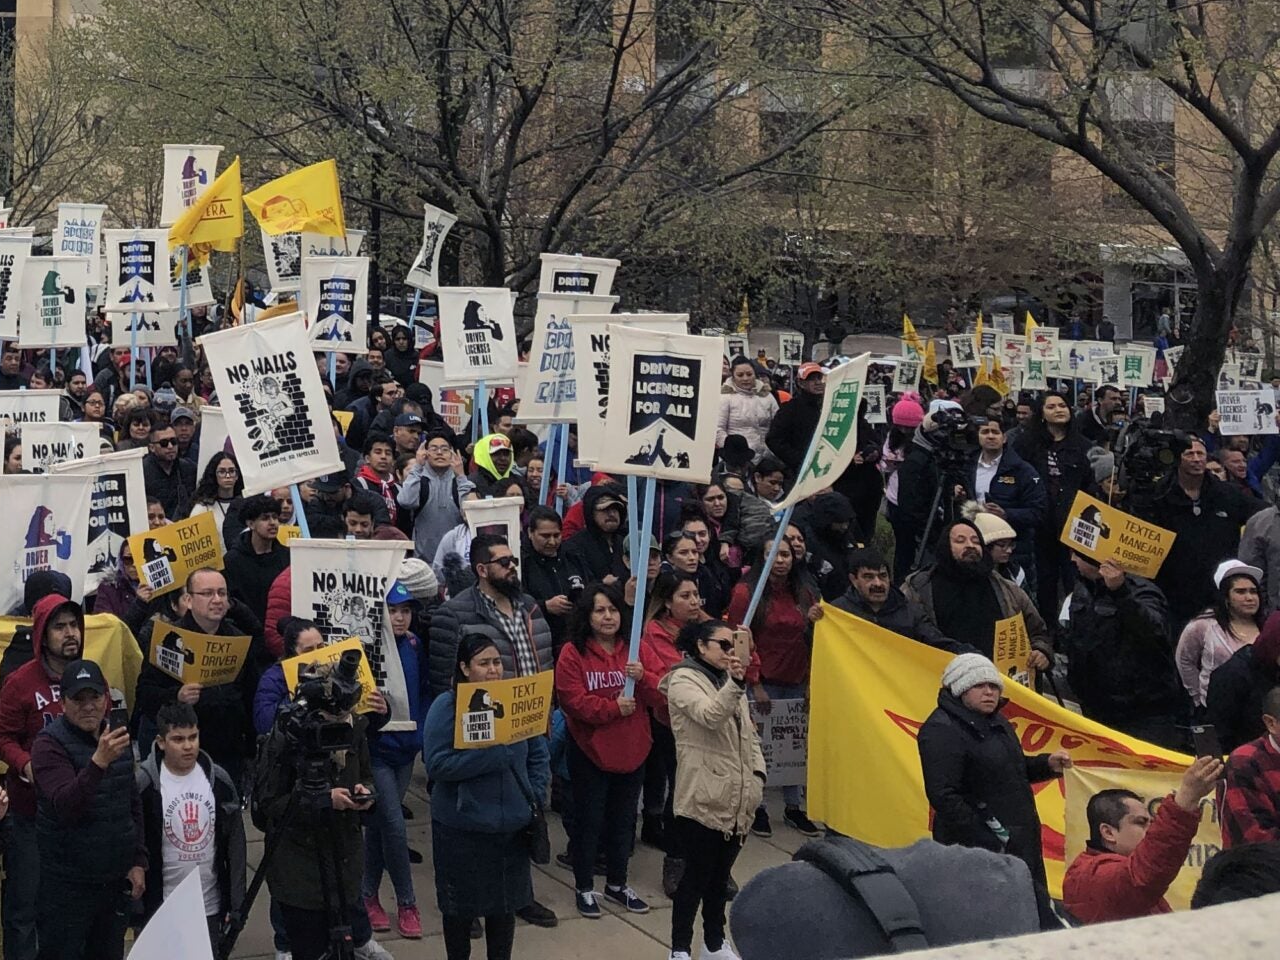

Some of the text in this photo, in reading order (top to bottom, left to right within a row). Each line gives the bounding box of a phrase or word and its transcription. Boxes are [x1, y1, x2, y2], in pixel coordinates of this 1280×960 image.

[122, 244, 150, 254] DRIVER
[121, 255, 152, 265] LICENSES
[121, 266, 152, 275] FOR ALL
[322, 282, 351, 291] DRIVER
[558, 277, 590, 287] DRIVER
[42, 296, 60, 307] DRIVER
[320, 292, 353, 302] LICENSES
[40, 307, 62, 318] LICENSES
[321, 303, 352, 312] FOR ALL
[42, 317, 62, 327] FOR ALL
[465, 331, 487, 343] DRIVER
[464, 343, 491, 355] LICENSES
[469, 354, 493, 366] FOR ALL
[225, 351, 298, 385] NO WALLS
[639, 361, 690, 379] DRIVER
[636, 381, 694, 399] LICENSES
[635, 403, 692, 419] FOR ALL
[1220, 405, 1247, 414] LICENSES
[1232, 414, 1242, 422] ALL
[32, 443, 49, 459] NO
[89, 512, 125, 527] OR ALL
[177, 523, 201, 541] TEXT
[1077, 521, 1095, 534] DRIVER
[1124, 520, 1162, 543] TEXTEA
[1074, 527, 1096, 541] LICENSES
[181, 535, 213, 557] DRIVER
[1083, 538, 1093, 548] ALL
[1119, 533, 1165, 557] MANEJAR
[25, 549, 49, 567] DRIVER
[185, 559, 195, 569] TO
[147, 560, 165, 574] DRIVER
[149, 569, 170, 583] LICENSES
[154, 575, 172, 590] FOR ALL
[313, 571, 388, 599] NO WALLS
[997, 630, 1007, 661] TEXTEA
[1008, 621, 1018, 659] MANEJAR
[206, 641, 232, 653] TEXT
[202, 655, 238, 667] DRIVER
[200, 669, 210, 678] TO
[512, 682, 537, 698] TEXT
[511, 696, 544, 716] DRIVER
[469, 713, 488, 723] DRIVER
[511, 718, 520, 728] TO
[466, 722, 491, 733] LICENSES
[470, 731, 491, 740] FOR ALL
[165, 792, 215, 818] TODOS SOMOS MKE
